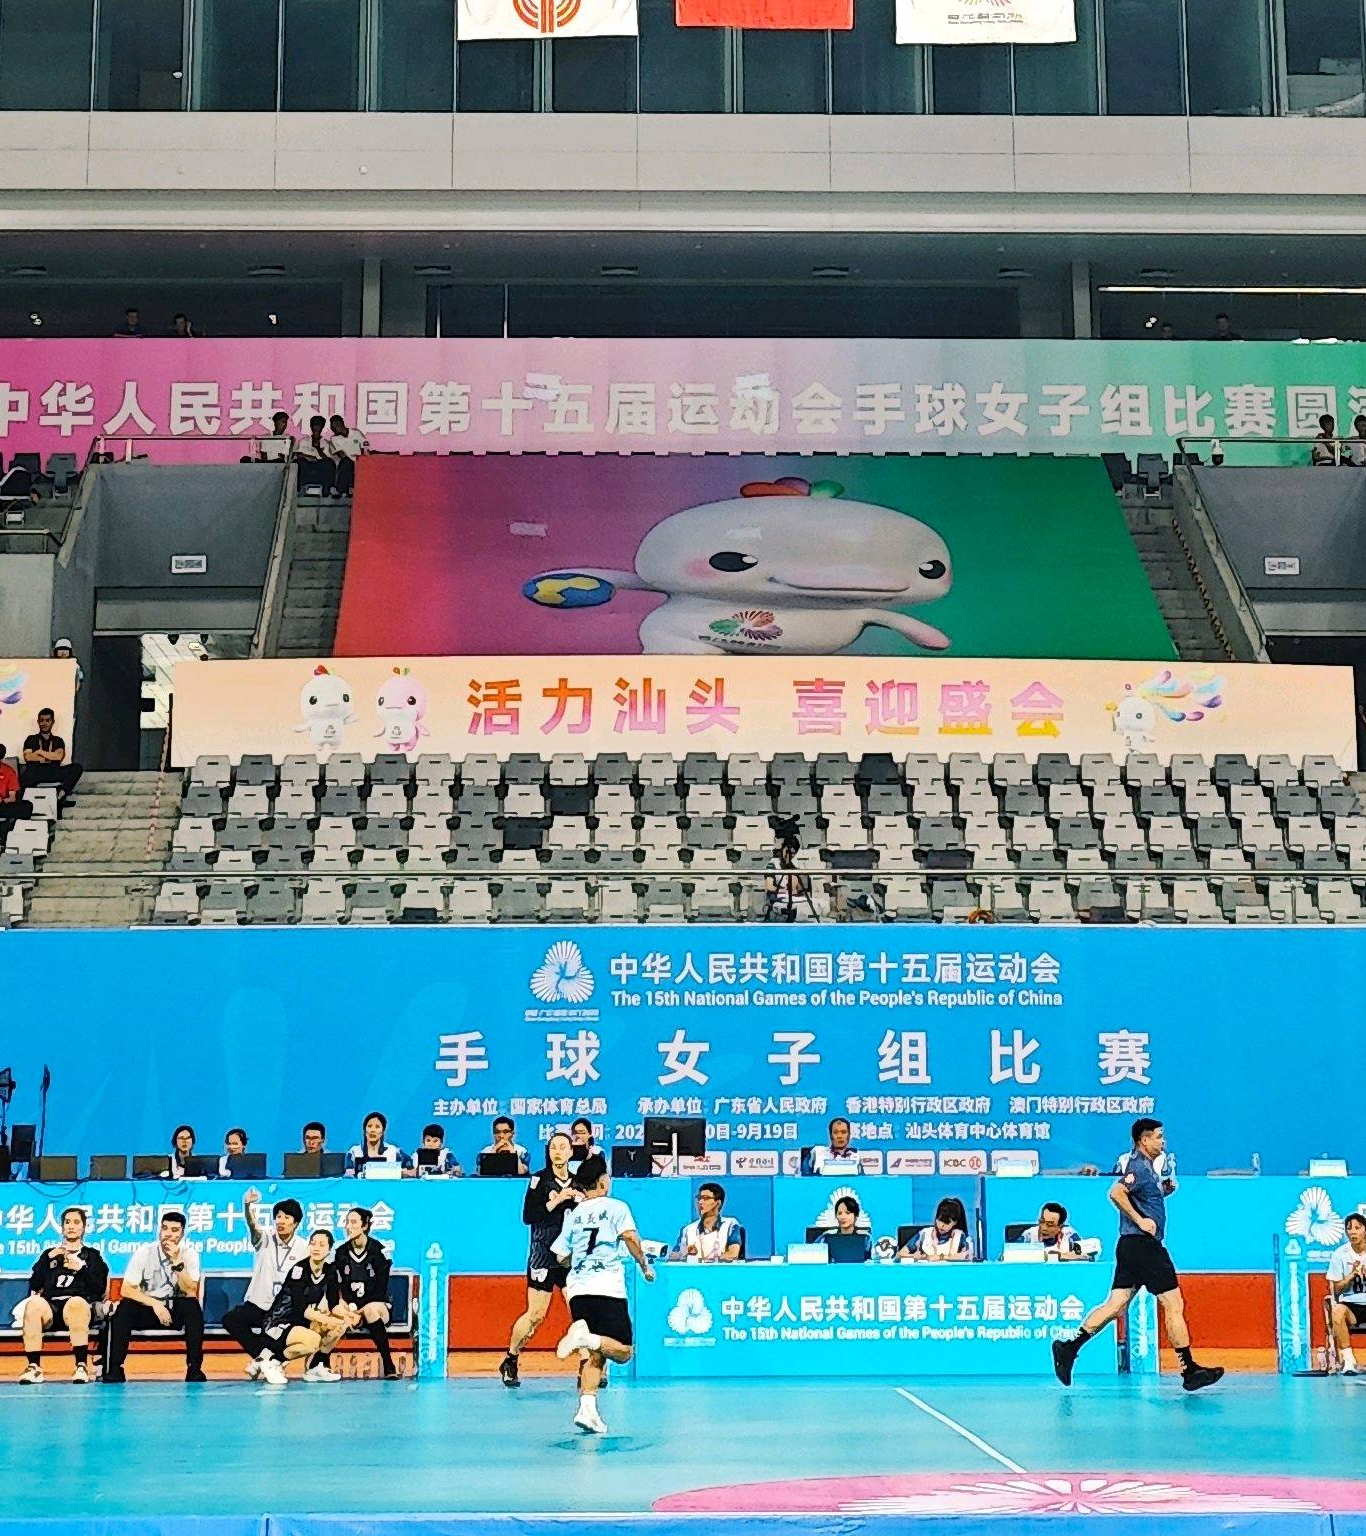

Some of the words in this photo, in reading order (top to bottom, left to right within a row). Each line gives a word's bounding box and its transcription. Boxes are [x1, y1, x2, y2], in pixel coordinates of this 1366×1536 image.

[467, 676, 741, 737] 活力汕头
[791, 677, 1065, 738] 喜迎盛会
[609, 951, 1062, 985] 中华人民共和国第十五届运动会
[611, 989, 641, 1006] The
[646, 989, 680, 1006] 15th
[683, 989, 750, 1006] National
[752, 989, 807, 1006] Games
[810, 989, 827, 1006] of
[830, 989, 855, 1006] the
[859, 989, 924, 1009] People's
[927, 989, 995, 1009] Republic
[998, 989, 1015, 1006] of
[1018, 989, 1063, 1006] China
[434, 1028, 1153, 1087] 手球女子组比赛
[509, 1098, 608, 1116] 国家体育总局
[713, 1097, 827, 1115] 广东省人民政府
[846, 1096, 992, 1115] 香港特别行政区政府
[1009, 1096, 1155, 1115] 澳门特别行政区政府
[905, 1121, 1052, 1141] 汕头体育中心体育馆
[582, 1227, 600, 1255] 7
[721, 1294, 1086, 1323] 中华人民共和国第十五届运动会
[780, 1325, 833, 1338] National
[836, 1325, 880, 1338] Games
[882, 1325, 897, 1338] of
[898, 1325, 919, 1338] the
[977, 1325, 1031, 1341] Republic
[1033, 1325, 1047, 1338] of
